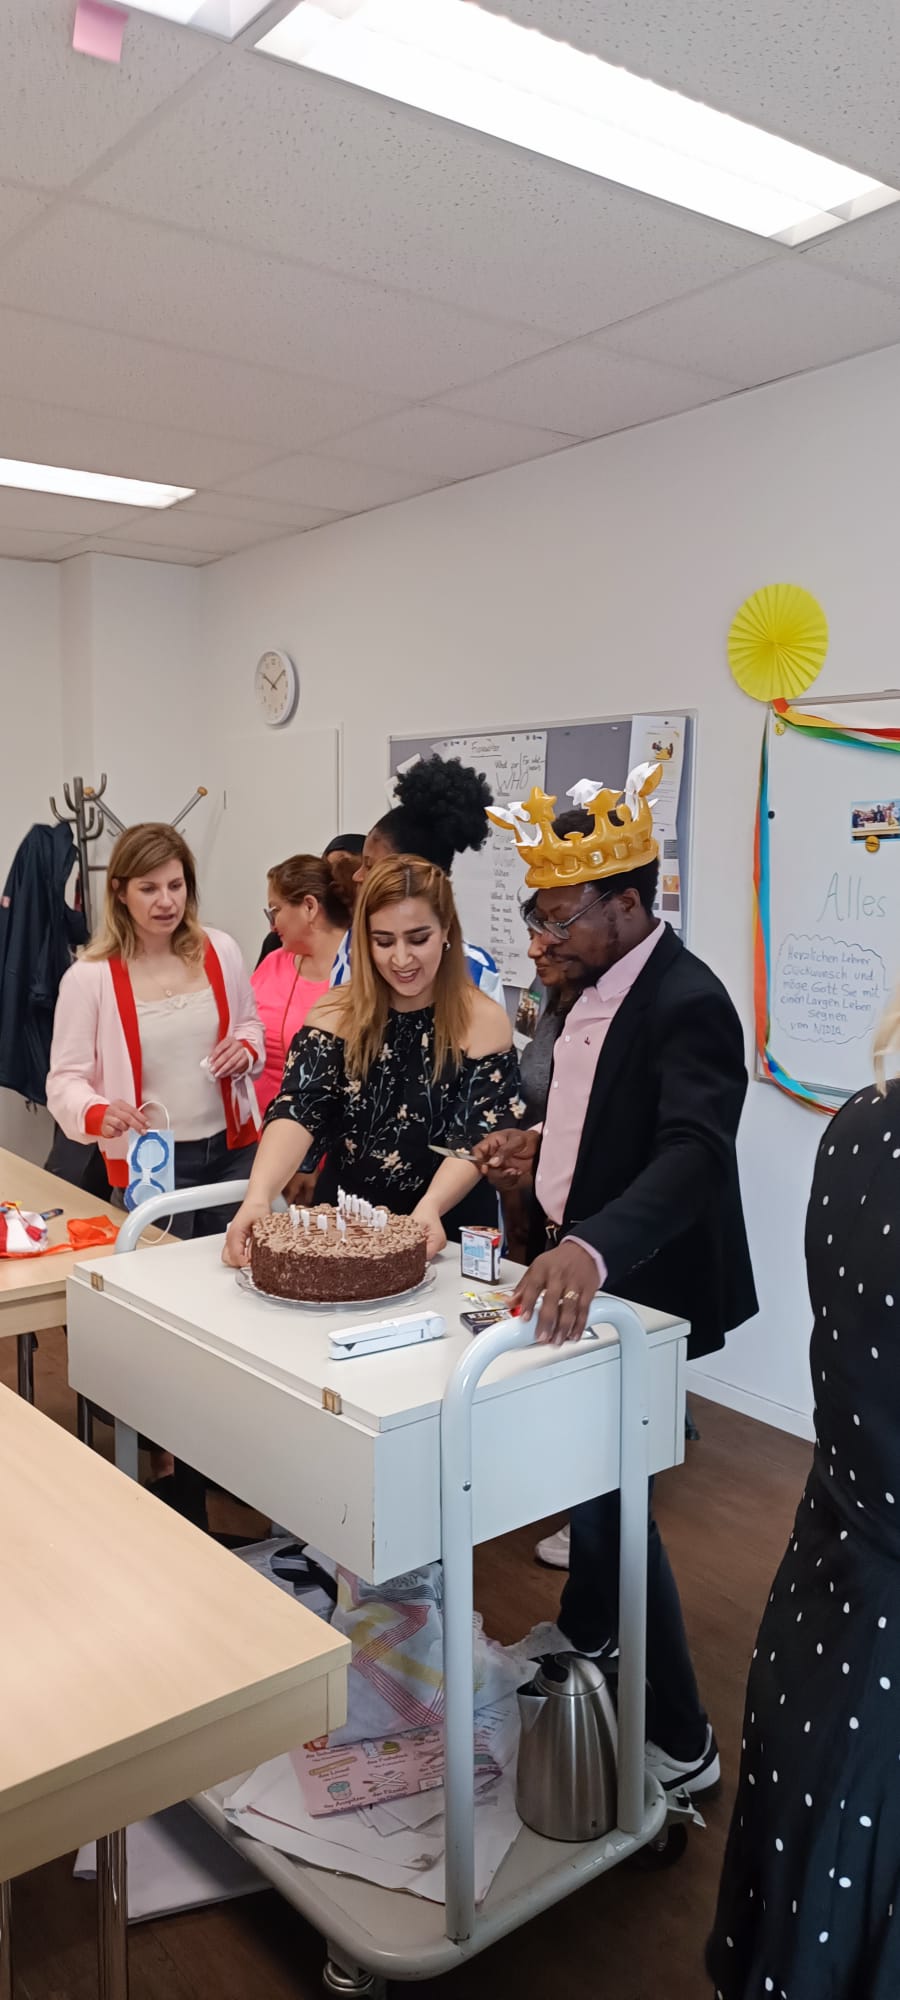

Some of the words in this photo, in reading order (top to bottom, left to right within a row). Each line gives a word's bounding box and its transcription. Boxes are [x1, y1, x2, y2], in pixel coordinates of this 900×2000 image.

[495, 768, 529, 791] WHO
[816, 871, 887, 922] Alles
[854, 969, 873, 981] und
[811, 981, 838, 996] Gott
